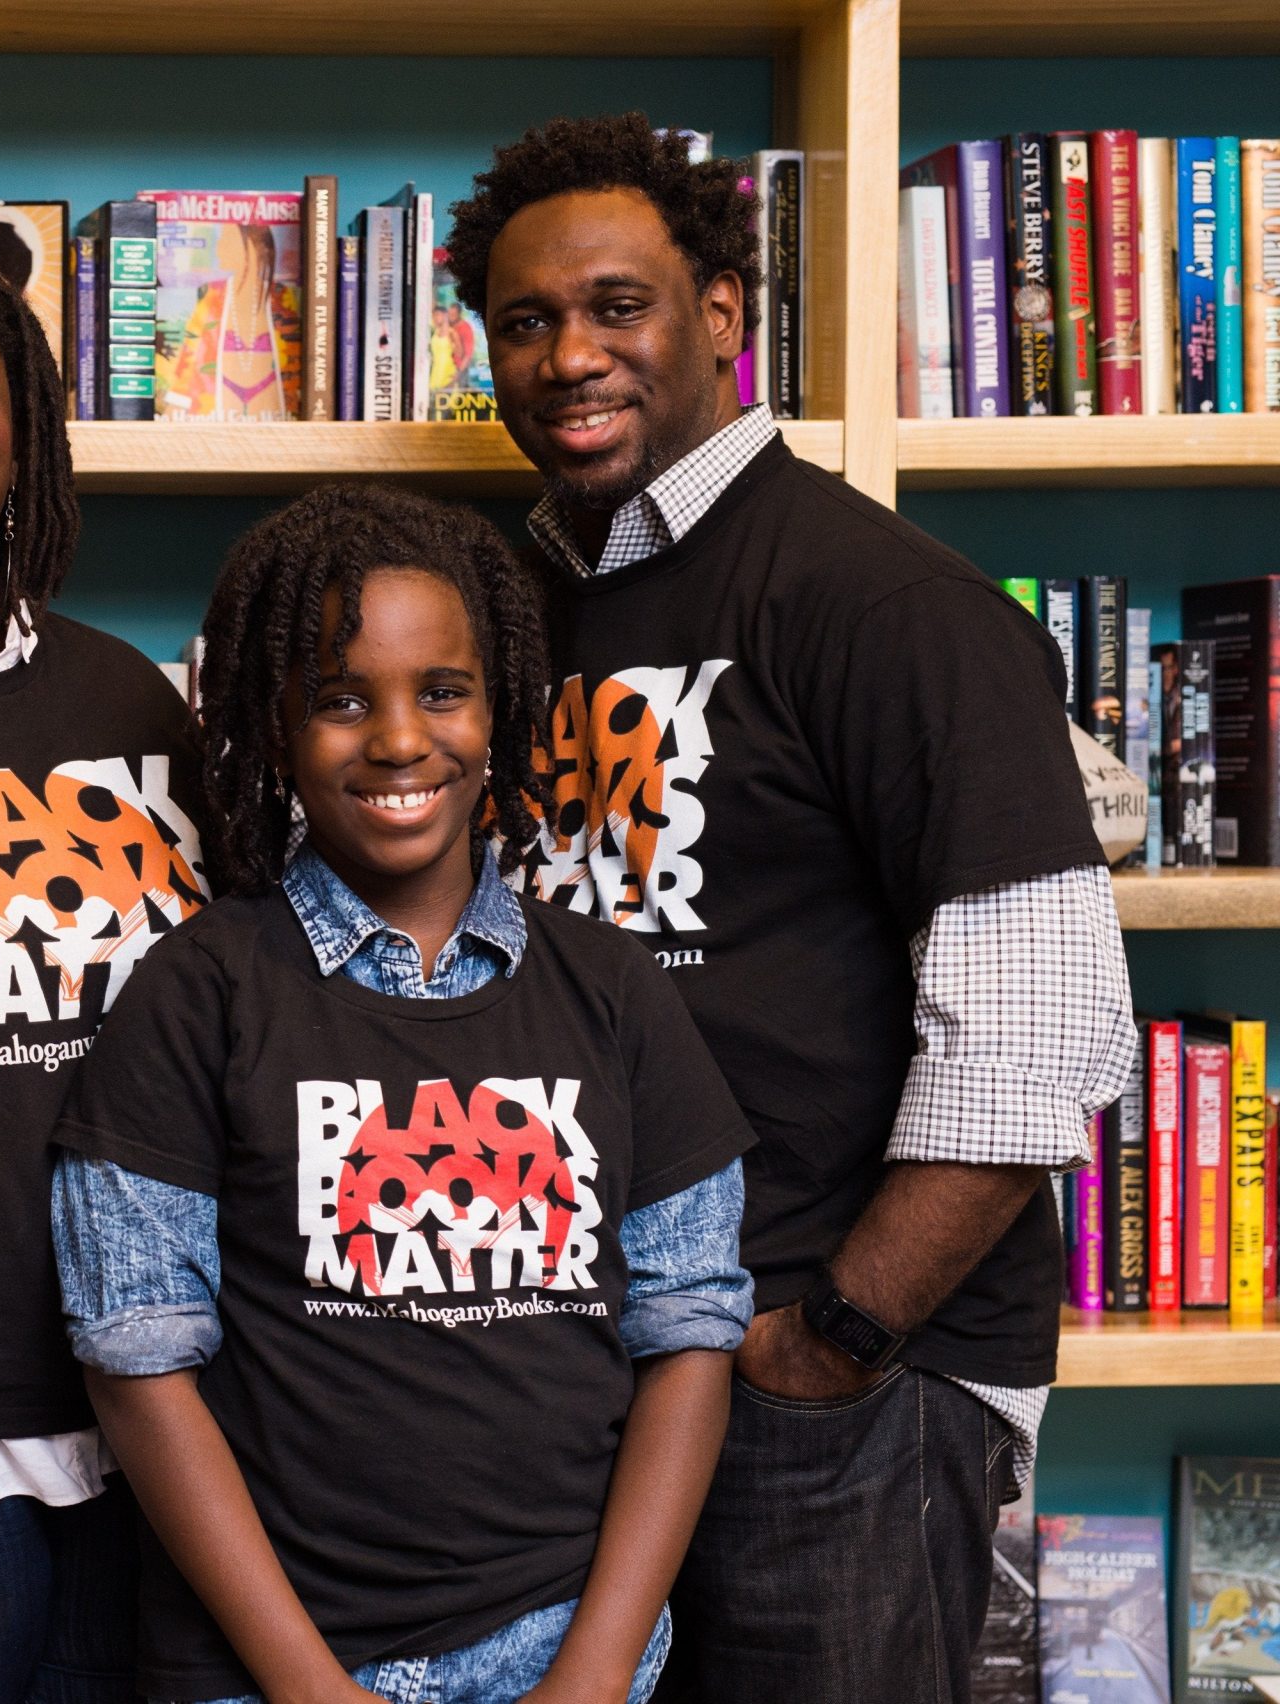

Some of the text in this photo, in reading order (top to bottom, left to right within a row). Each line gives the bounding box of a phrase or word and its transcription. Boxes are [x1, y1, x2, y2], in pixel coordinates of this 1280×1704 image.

[180, 194, 253, 226] McElroy
[788, 168, 797, 201] LORD
[1022, 142, 1044, 283] STEVE BERRY
[1111, 145, 1131, 277] THE DA VINCI CODE
[315, 189, 329, 297] MARY HIGGINS CLARK
[921, 217, 935, 257] DAVID
[1066, 177, 1090, 307] FAST SHUFFLE
[1186, 157, 1216, 281] Tom Clancy
[378, 232, 393, 320] PATRICIA CORNWELL
[788, 256, 797, 296] NOVEL
[1115, 287, 1132, 316] DAN
[315, 327, 329, 355] WALK
[781, 302, 790, 404] JOHN CROWLEY
[971, 256, 999, 393] TOTAL CONTROL
[1187, 320, 1208, 381] Tiger
[315, 356, 329, 391] ALONE
[375, 355, 393, 422] SCARPETTA
[1021, 322, 1035, 402] DECEPTION
[1034, 330, 1049, 392] KING'S
[1099, 584, 1117, 688] THE TESTAMENT
[1154, 1031, 1177, 1132] JAMES PATTERSON
[1197, 1073, 1221, 1109] JAMES
[296, 1077, 600, 1162] BLACK
[1197, 1109, 1221, 1166] PATTERSON
[1234, 1062, 1265, 1188] THE EXPATS
[297, 1150, 604, 1238] BOOKS
[1120, 1166, 1142, 1211] ALEX
[303, 1228, 600, 1297] MATTER
[1120, 1215, 1143, 1278] CROSS
[303, 1292, 609, 1328] www.MahoganyBooks.com
[1187, 1676, 1254, 1693] MILTON
